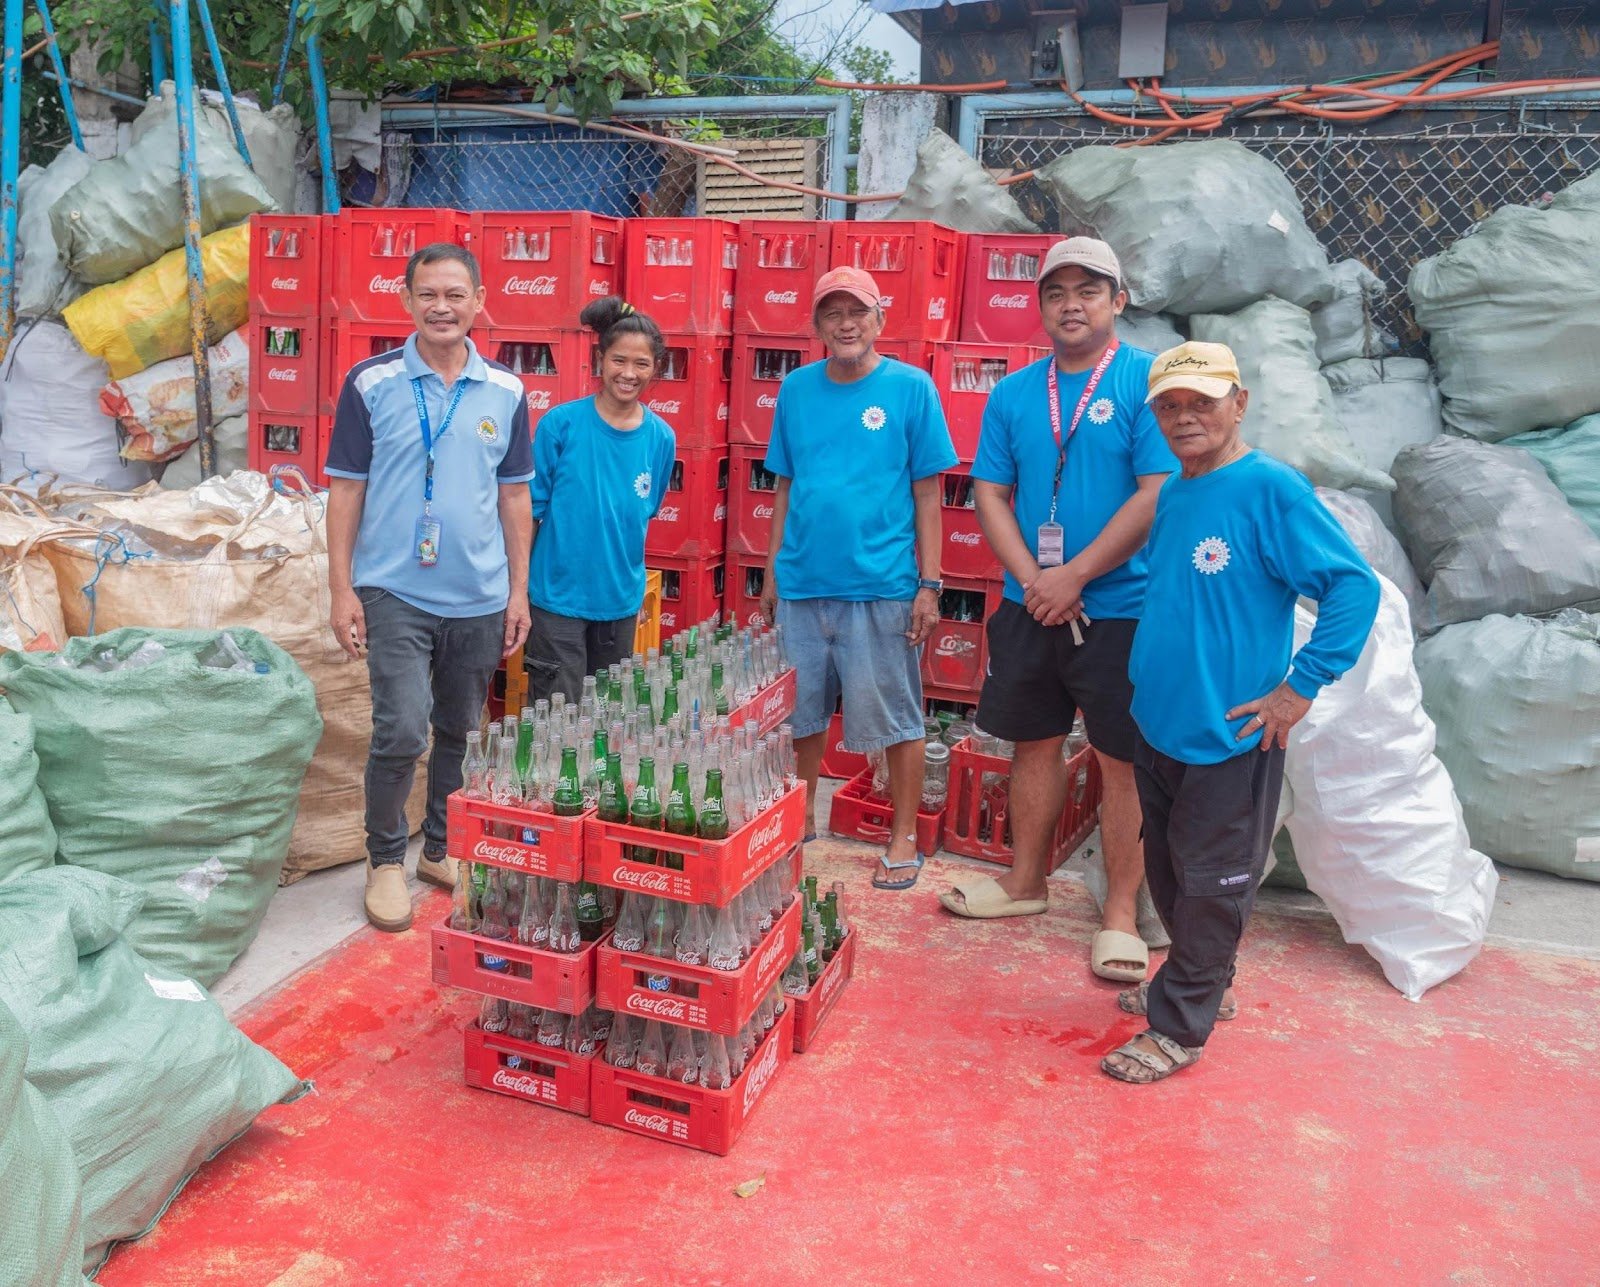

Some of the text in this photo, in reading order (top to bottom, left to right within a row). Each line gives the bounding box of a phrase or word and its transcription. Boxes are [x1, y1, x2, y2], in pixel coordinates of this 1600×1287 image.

[502, 276, 558, 296] Coca-Cola
[989, 294, 1030, 308] Coca-Cola
[1087, 348, 1116, 391] BARANGAY
[950, 531, 982, 546] Coca-Cola
[474, 841, 528, 866] Coca-Cola
[612, 866, 671, 892] Coca-Cola
[626, 993, 687, 1019] Coca-Cola
[493, 1070, 539, 1096] Coca-Cola
[624, 1109, 670, 1135] Coca-Cola
